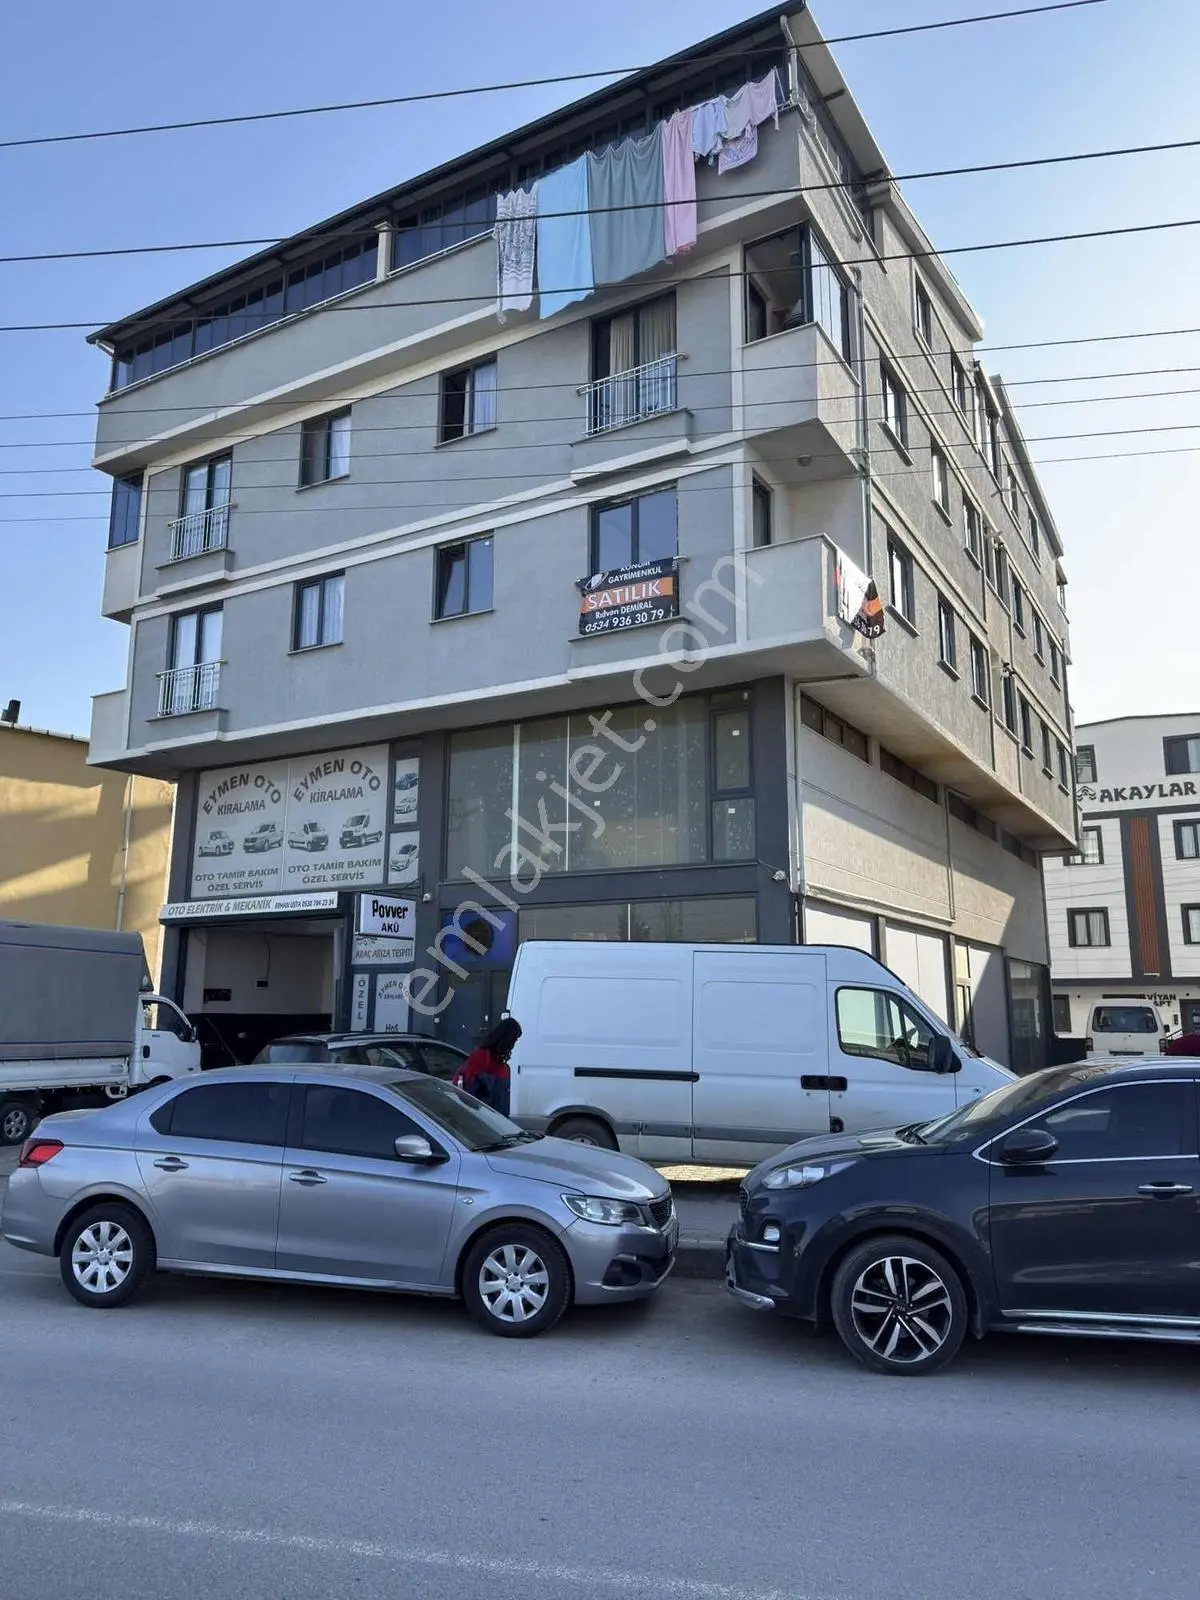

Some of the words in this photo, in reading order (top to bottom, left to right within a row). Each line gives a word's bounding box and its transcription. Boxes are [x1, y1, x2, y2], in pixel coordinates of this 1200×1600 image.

[585, 621, 609, 633] 0534
[612, 616, 632, 627] 936
[635, 612, 648, 624] 30
[651, 608, 664, 621] 79
[293, 759, 345, 802] EYMEN
[350, 760, 381, 791] OTO
[203, 773, 250, 815] EYMEN
[254, 775, 282, 804] OTO
[1099, 781, 1197, 803] AKAYLAR
[195, 873, 215, 882] OTO
[248, 867, 279, 878] BAKIM
[288, 864, 310, 873] OTO
[347, 858, 382, 869] BAKIM
[168, 906, 185, 916] OTO
[381, 922, 400, 933] AKÜ
